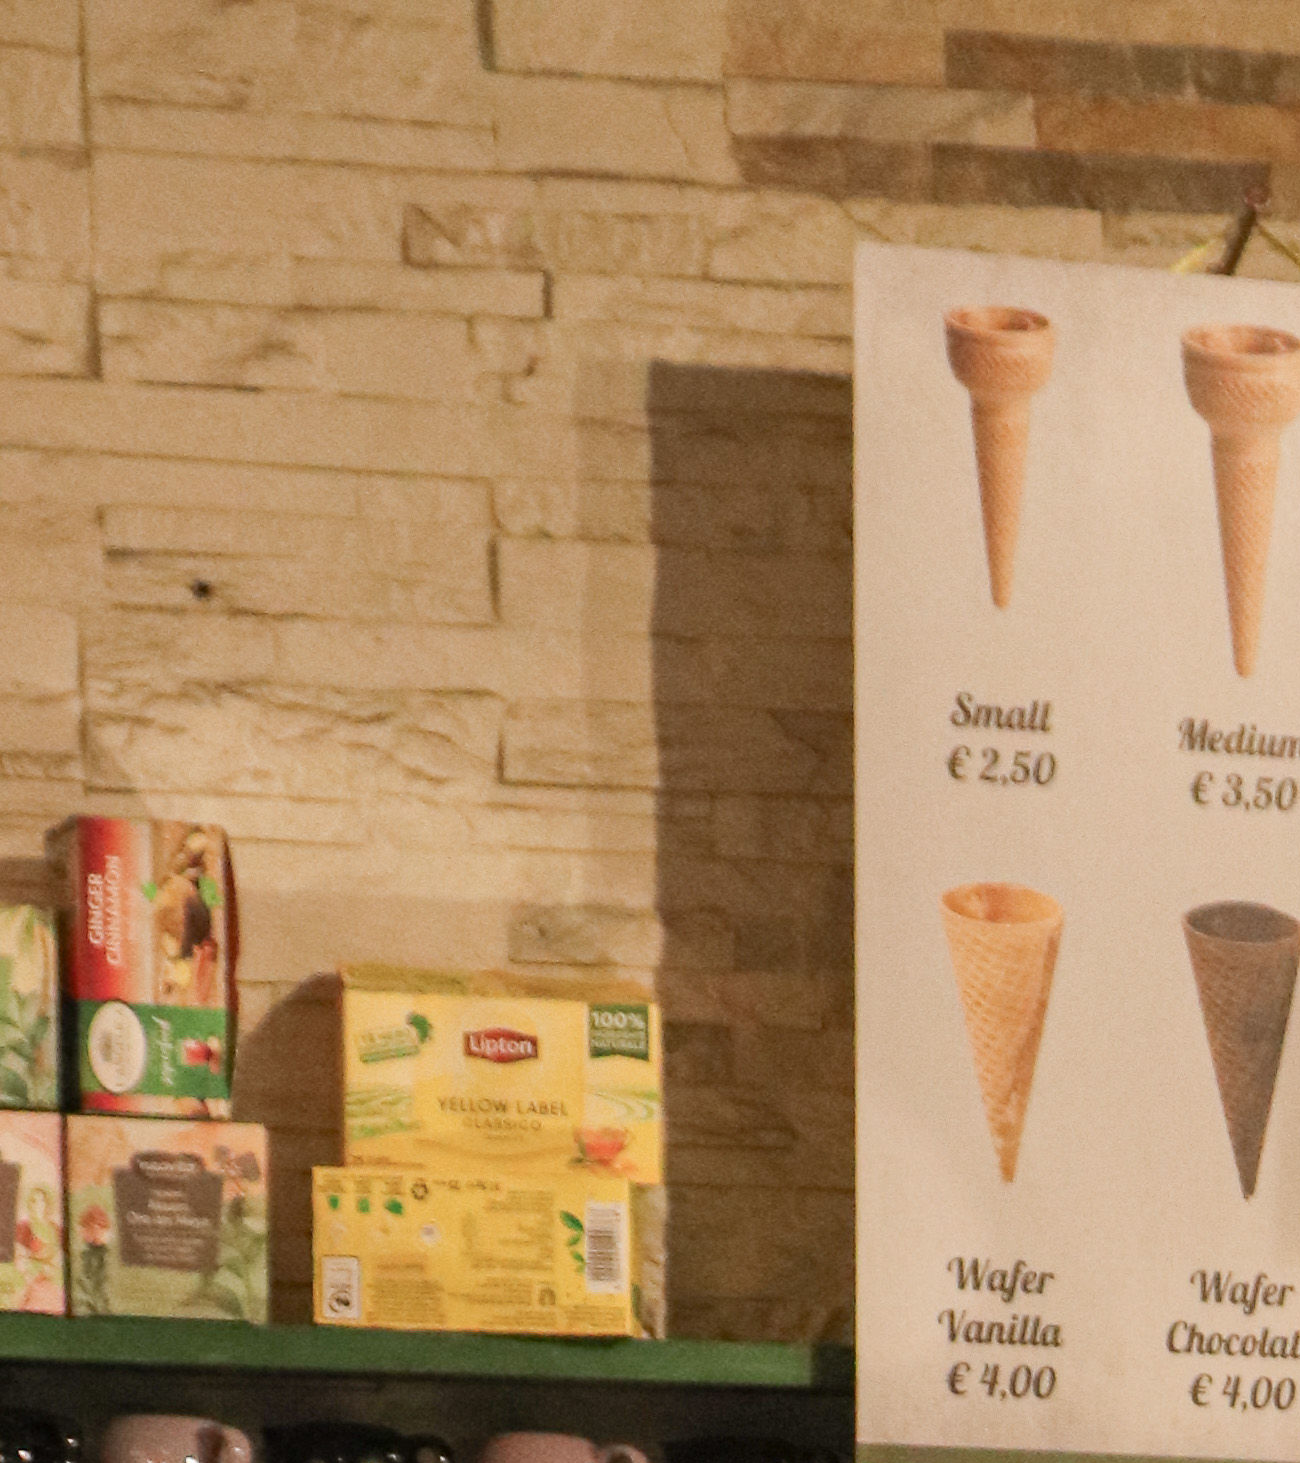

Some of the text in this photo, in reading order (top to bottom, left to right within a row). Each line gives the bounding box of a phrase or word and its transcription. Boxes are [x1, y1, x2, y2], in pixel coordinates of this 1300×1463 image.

[950, 693, 1051, 734] Small
[947, 746, 1057, 787] € 2,50
[1190, 772, 1298, 812] € 3,50
[87, 871, 104, 945] GINGER
[105, 854, 121, 966] CINNAMON
[591, 1010, 646, 1028] 100%
[469, 1033, 534, 1055] Lipton
[437, 1097, 568, 1117] YELLOW LABEL
[947, 1257, 1055, 1304] Wafer
[1190, 1270, 1295, 1316] Wafer
[937, 1309, 1063, 1348] Vanilla
[947, 1362, 1057, 1400] € 4,00
[1189, 1374, 1296, 1411] € 4,00
